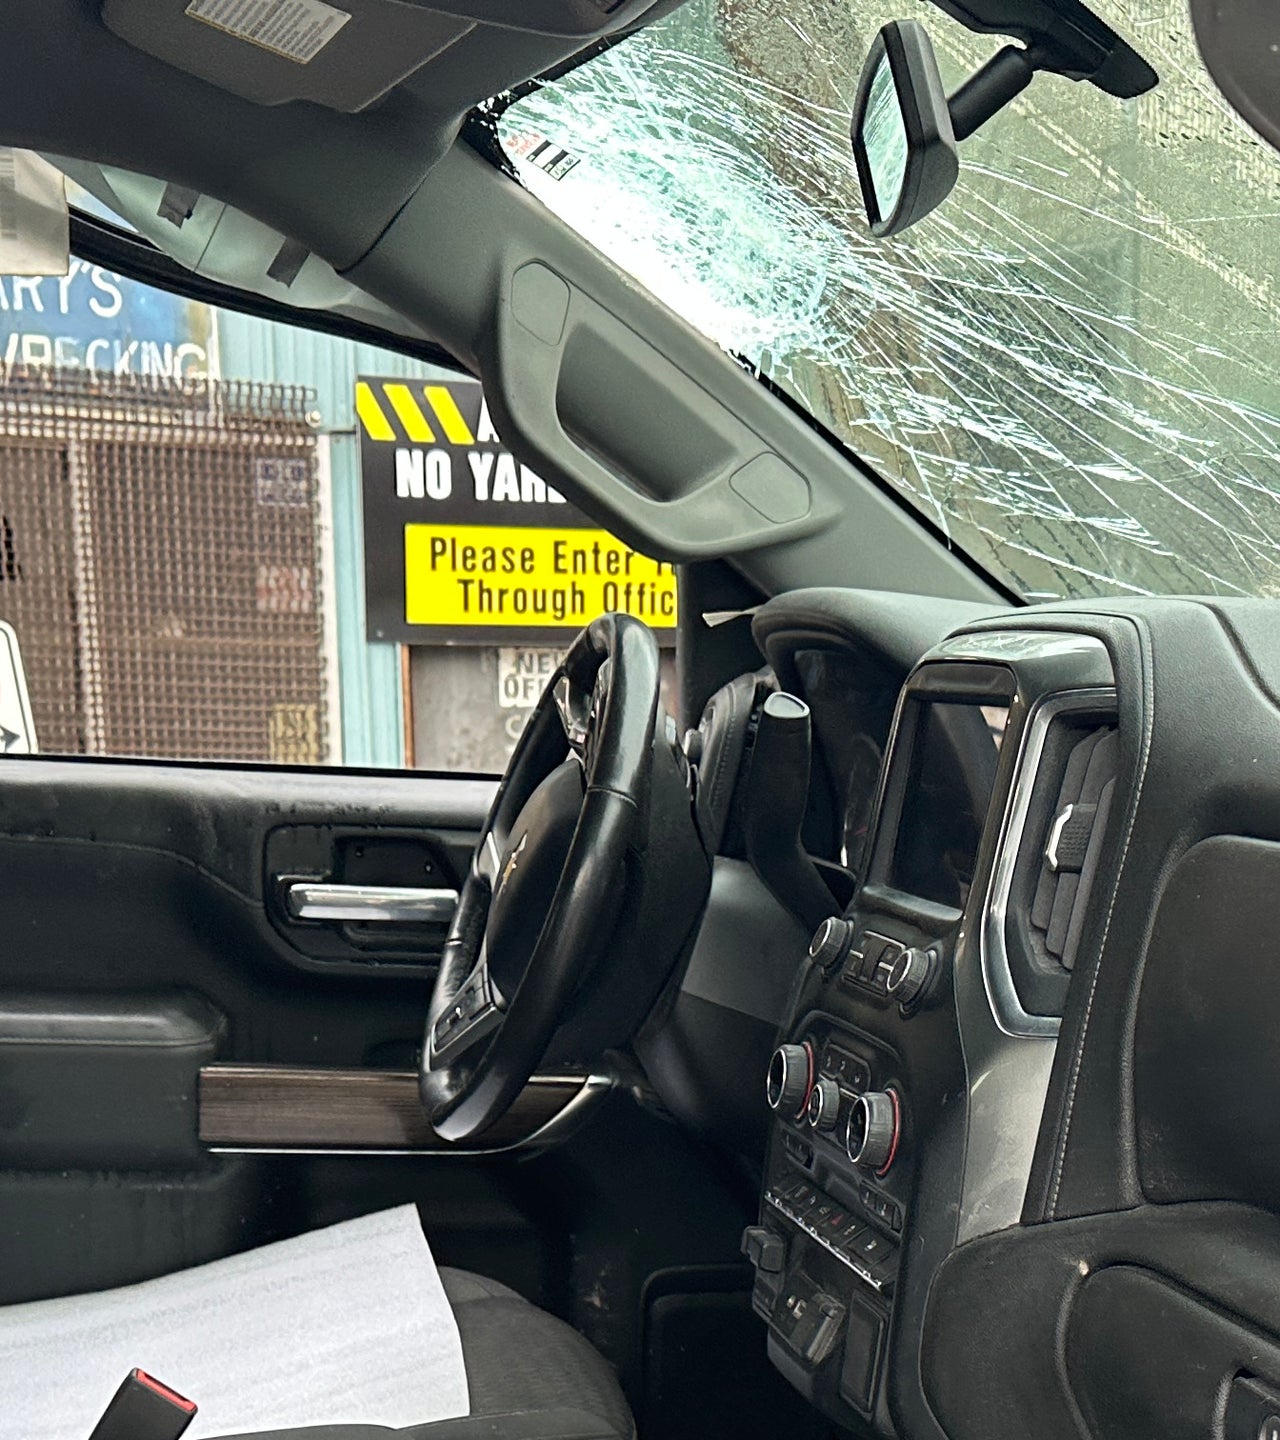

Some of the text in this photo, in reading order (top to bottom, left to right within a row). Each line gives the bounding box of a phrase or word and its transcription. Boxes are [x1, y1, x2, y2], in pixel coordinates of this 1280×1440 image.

[395, 448, 568, 503] NO YAR
[430, 536, 535, 572] Please
[554, 540, 635, 576] Enter
[457, 578, 674, 620] Through Offic
